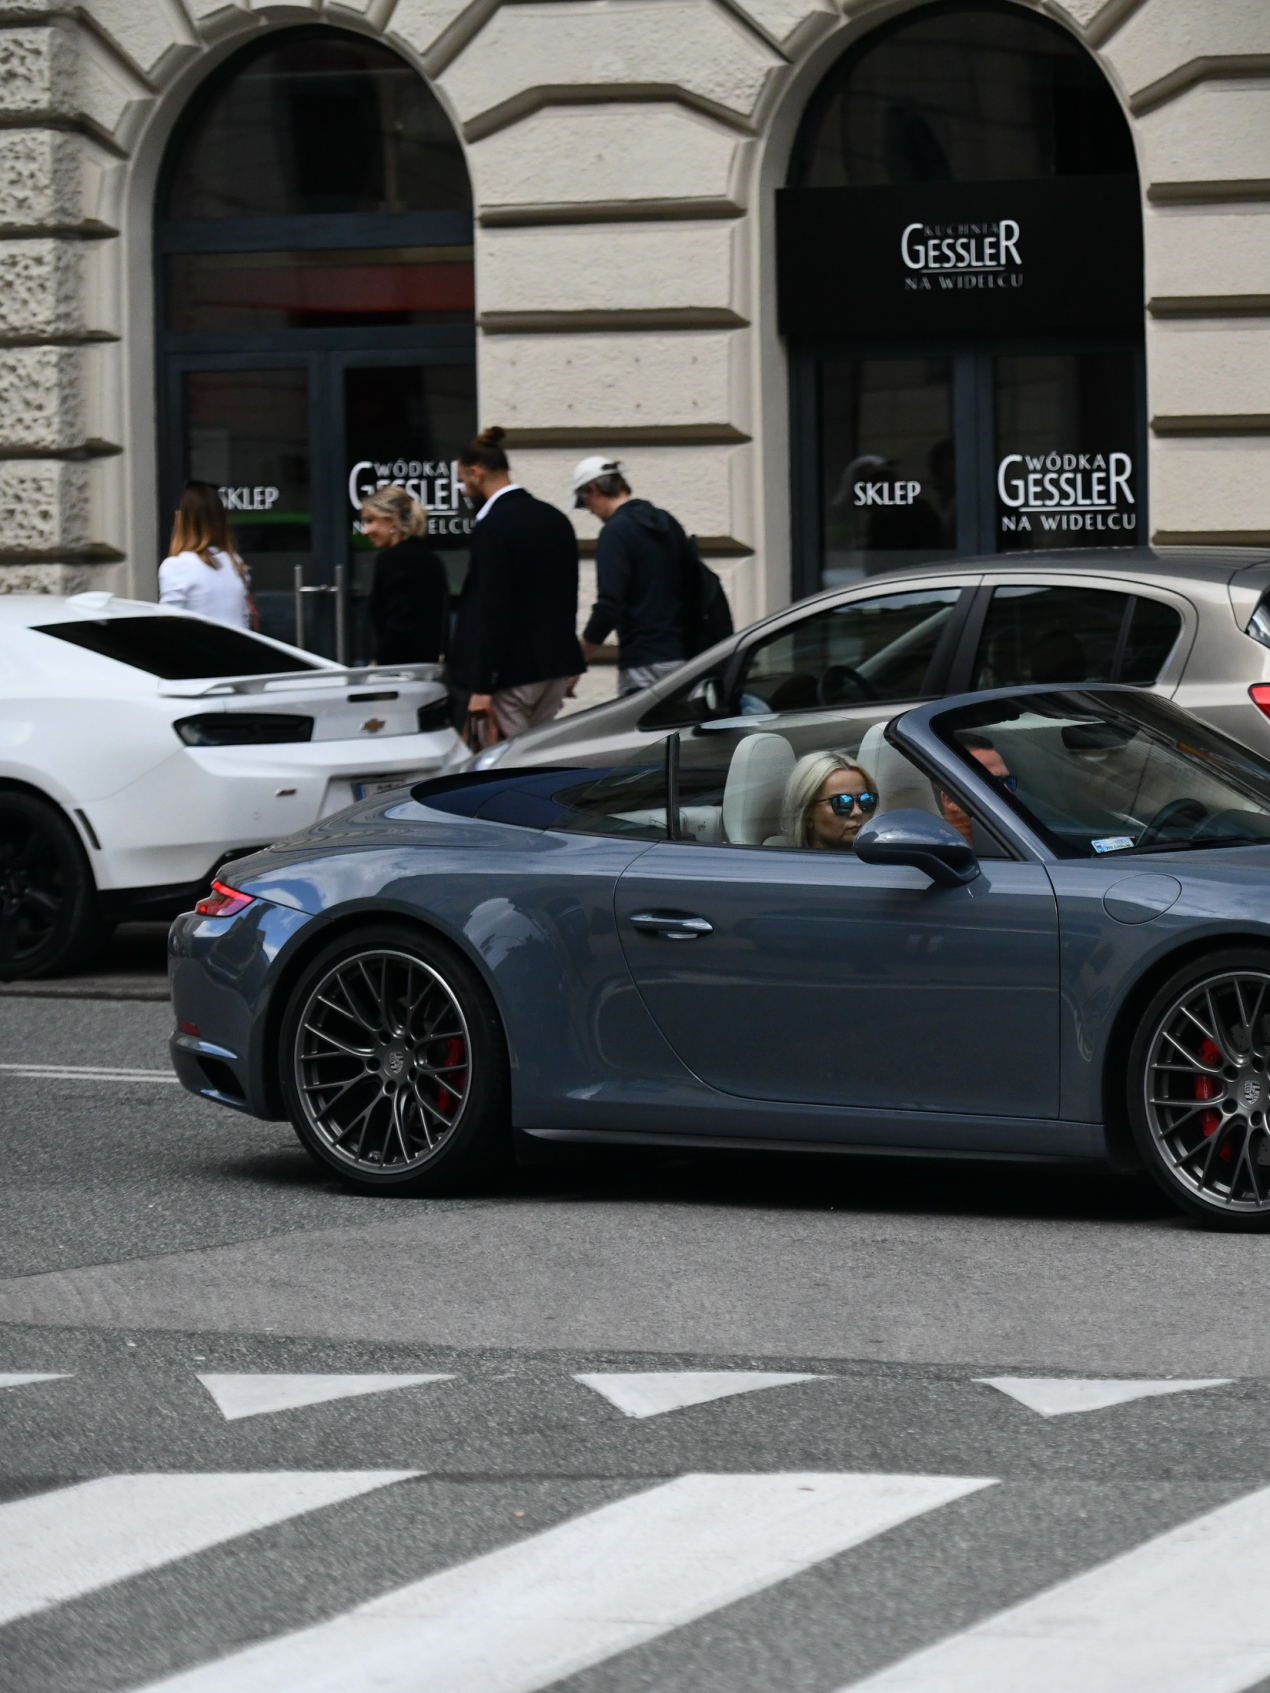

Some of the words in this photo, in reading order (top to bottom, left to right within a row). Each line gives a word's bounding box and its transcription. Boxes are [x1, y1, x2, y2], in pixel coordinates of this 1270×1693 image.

[923, 222, 1000, 237] KUCHNIA
[904, 276, 932, 290] NA
[938, 273, 1024, 289] WIDELCU
[374, 457, 450, 477] WÓDKA
[1024, 450, 1106, 471] WÓDKA
[853, 481, 921, 505] SKLEP
[1002, 515, 1032, 531] NA
[1040, 513, 1136, 531] WIDELCU
